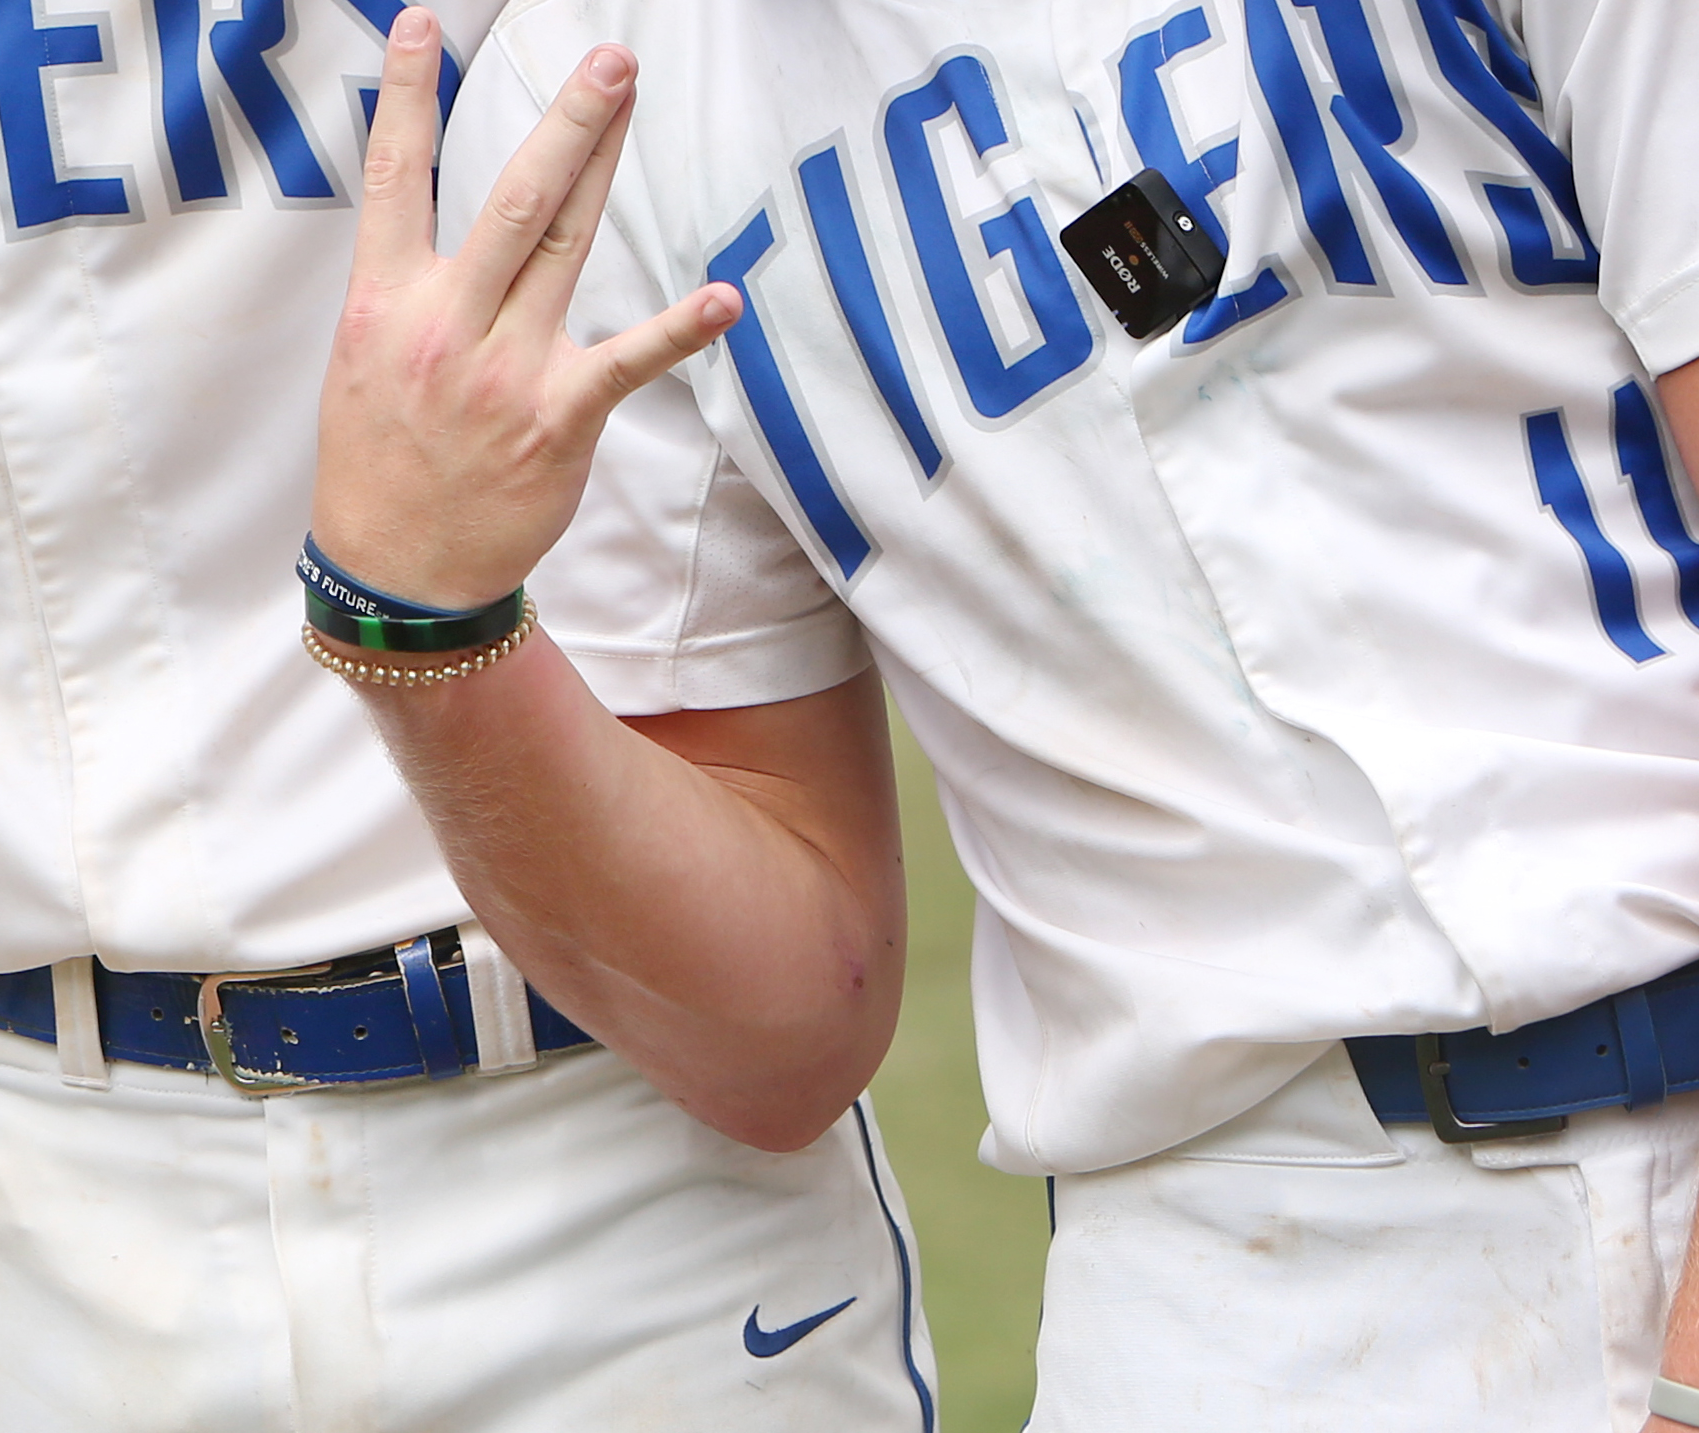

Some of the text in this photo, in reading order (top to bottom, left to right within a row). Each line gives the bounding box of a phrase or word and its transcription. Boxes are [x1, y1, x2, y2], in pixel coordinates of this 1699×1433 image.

[1101, 244, 1142, 294] RØDE
[1139, 241, 1170, 280] WIRELESS
[321, 574, 377, 616] FUTURE
